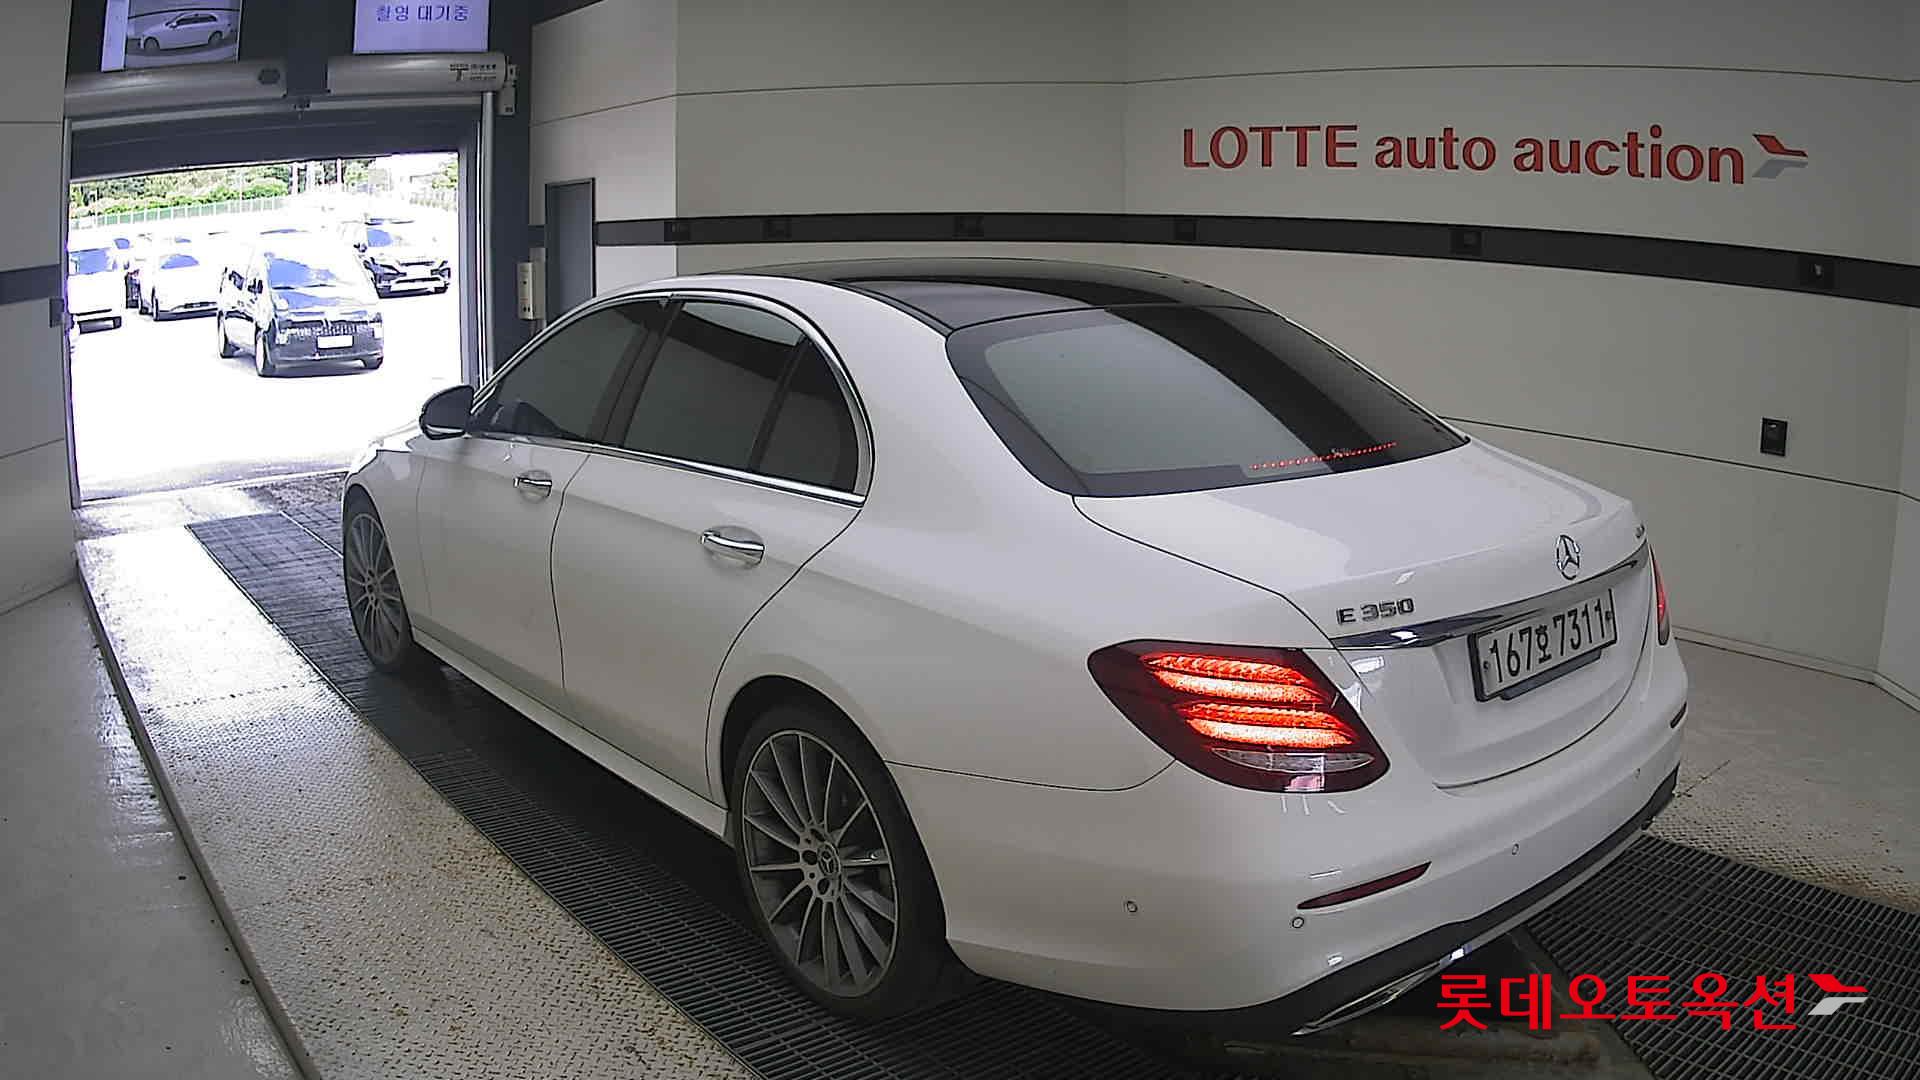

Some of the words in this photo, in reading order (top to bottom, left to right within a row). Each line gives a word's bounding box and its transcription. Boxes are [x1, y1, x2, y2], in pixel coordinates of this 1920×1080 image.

[417, 4, 469, 22] 대기중
[1182, 124, 1359, 170] LOTTE
[1374, 126, 1498, 171] auto
[1513, 123, 1746, 186] auction
[1336, 607, 1357, 626] E
[1360, 597, 1415, 622] 350
[1488, 597, 1606, 684] 167호7311
